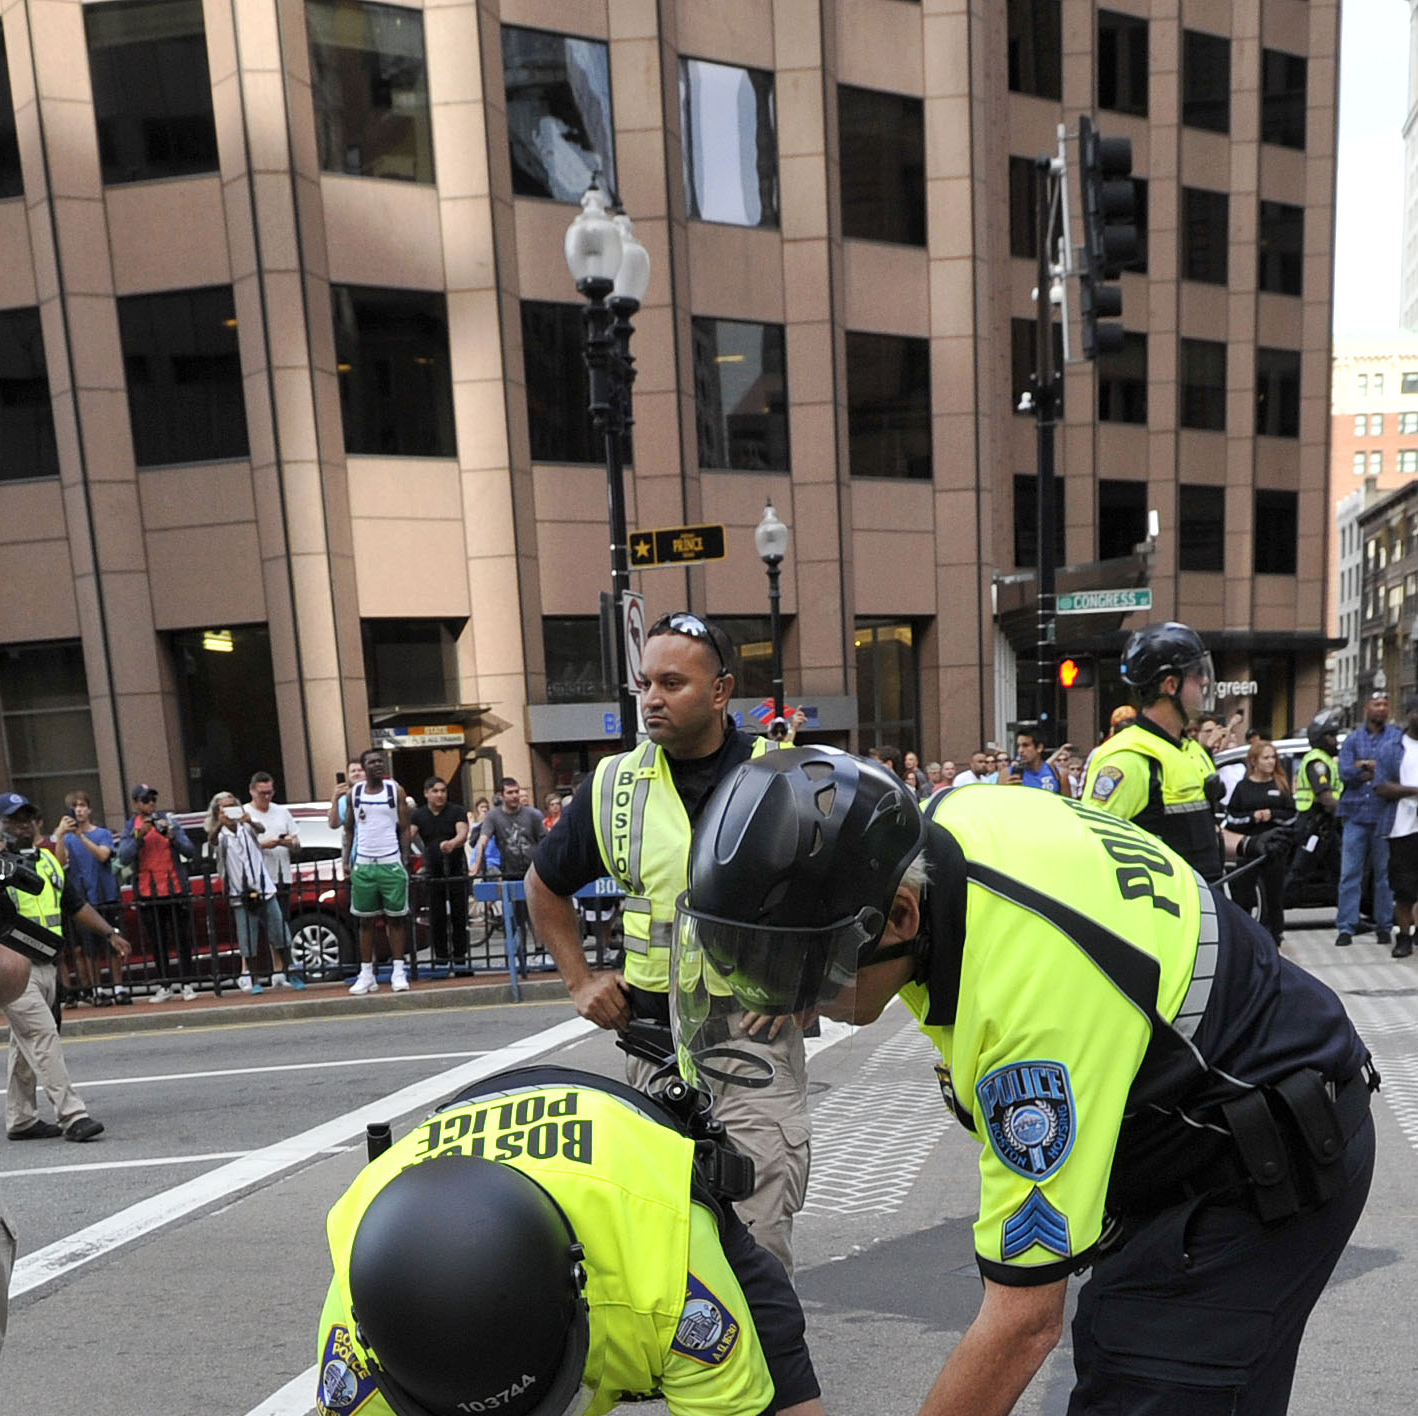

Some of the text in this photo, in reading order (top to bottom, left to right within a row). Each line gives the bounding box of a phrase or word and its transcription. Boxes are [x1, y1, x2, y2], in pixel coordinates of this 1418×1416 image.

[1073, 592, 1136, 609] CONGRESS
[1213, 681, 1258, 699] green
[1061, 798, 1181, 918] POLI
[595, 880, 627, 894] BO
[983, 1066, 1065, 1119] POLICE
[406, 1120, 593, 1168] BOST
[415, 1092, 579, 1157] POLICE
[991, 1122, 1028, 1169] BOSTON
[1047, 1104, 1069, 1159] HOUSING
[457, 1374, 536, 1413] 103744
